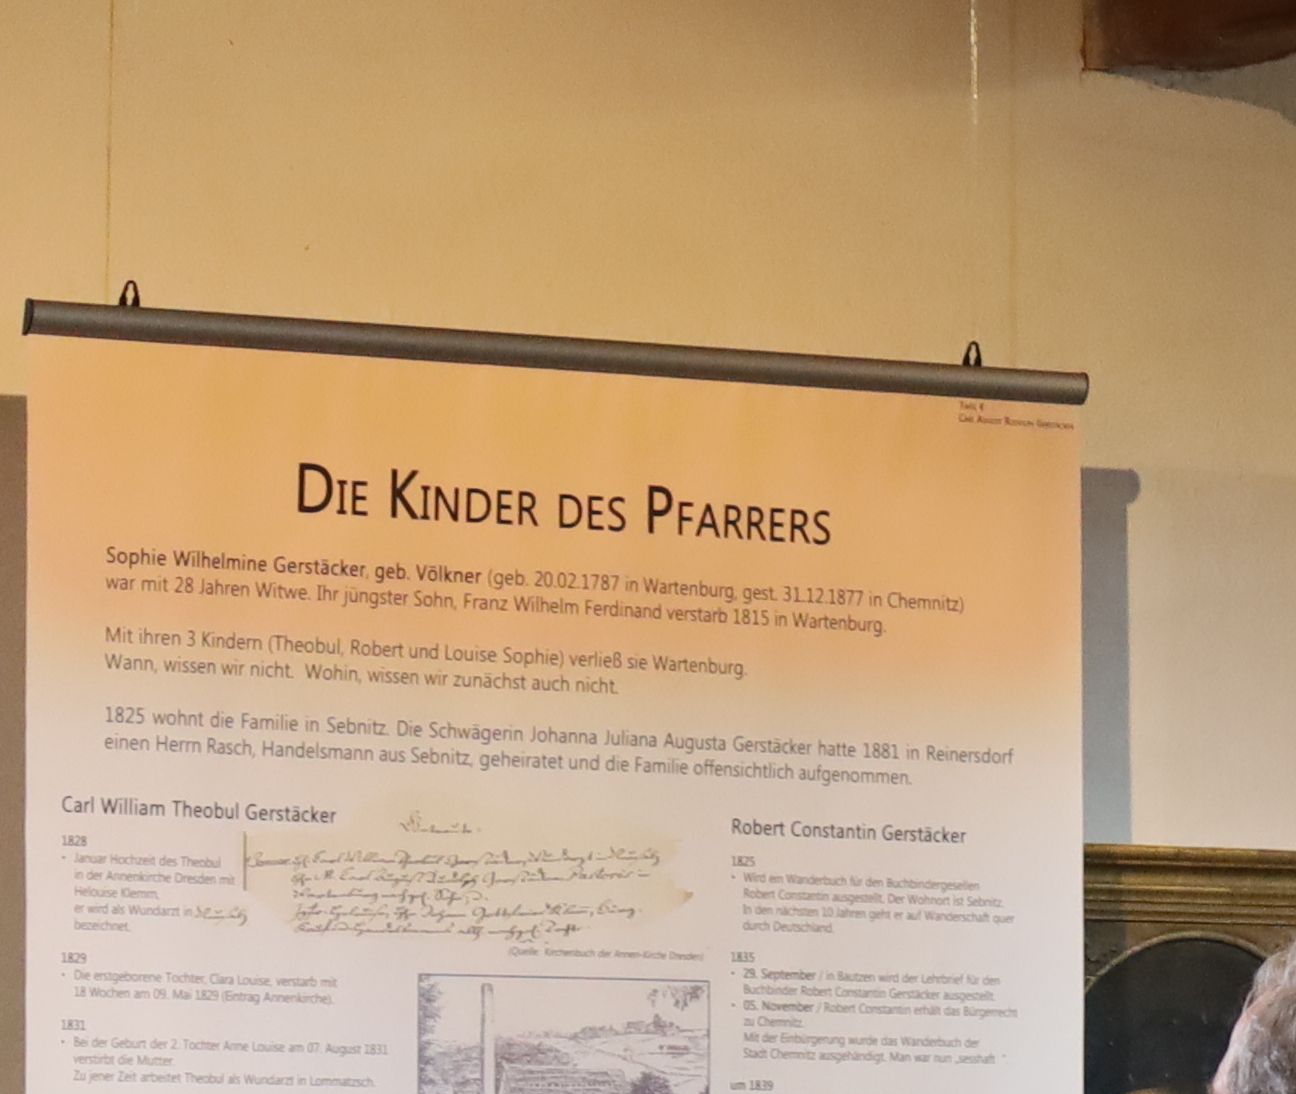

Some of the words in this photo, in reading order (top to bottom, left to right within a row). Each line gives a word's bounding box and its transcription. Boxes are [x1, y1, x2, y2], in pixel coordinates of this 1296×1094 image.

[105, 575, 135, 592] war
[140, 572, 169, 594] mit
[174, 574, 195, 595] 28
[199, 575, 250, 598] Jahren
[316, 582, 339, 603] Ihr
[343, 583, 408, 612] jüngster
[462, 590, 508, 612] Franz
[513, 593, 580, 616] Wilhelm
[584, 597, 663, 621] Ferdinand
[666, 601, 728, 625] verstarb
[732, 605, 770, 627] 1815
[773, 607, 788, 628] in
[106, 544, 167, 572] Sophie
[172, 548, 267, 573] Wilhelmine
[415, 561, 482, 585] Völkner
[534, 568, 620, 593] 20.02.1787
[624, 573, 639, 594] in
[783, 582, 864, 607] 31.12.1877
[868, 587, 883, 608] in
[886, 588, 965, 618] Chemnitz)
[104, 623, 133, 644] Mit
[138, 625, 182, 647] ihren
[186, 627, 196, 648] 3
[200, 628, 263, 651] Kindern
[349, 636, 404, 659] Robert
[407, 639, 440, 661] und
[443, 641, 498, 664] Louise
[502, 644, 564, 672] Sophie)
[568, 647, 622, 670] verließ
[626, 650, 648, 671] sie
[163, 653, 217, 676] wissen
[220, 656, 244, 677] wir
[367, 663, 420, 686] wissen
[423, 666, 448, 687] wir
[452, 667, 527, 691] zunächst
[531, 671, 570, 693] auch
[103, 730, 150, 752] einen
[261, 737, 374, 762] Handelsmann
[378, 747, 406, 763] aus
[478, 747, 564, 775] geheiratet
[567, 751, 600, 772] und
[604, 752, 629, 773] die
[633, 753, 689, 776] Familie
[692, 756, 794, 781] offensichtlich
[105, 704, 145, 725] 1825
[152, 706, 204, 728] wohnt
[209, 708, 234, 729] die
[240, 710, 299, 732] Familie
[304, 713, 320, 733] in
[396, 717, 423, 738] Die
[428, 718, 524, 748] Schwägerin
[530, 723, 598, 746] Johanna
[604, 727, 658, 749] Juliana
[663, 729, 726, 757] Augusta
[732, 732, 811, 756] Gerstäcker
[817, 736, 857, 758] hatte
[862, 738, 899, 760] 1881
[905, 740, 920, 761] in
[925, 741, 1014, 765] Reinersdorf
[61, 794, 95, 814] Carl
[100, 796, 166, 817] William
[173, 799, 240, 820] Theobul
[244, 802, 335, 824] Gerstäcker
[730, 817, 785, 836] Robert
[790, 819, 877, 840] Constantin
[881, 823, 965, 844] Gerstäcker
